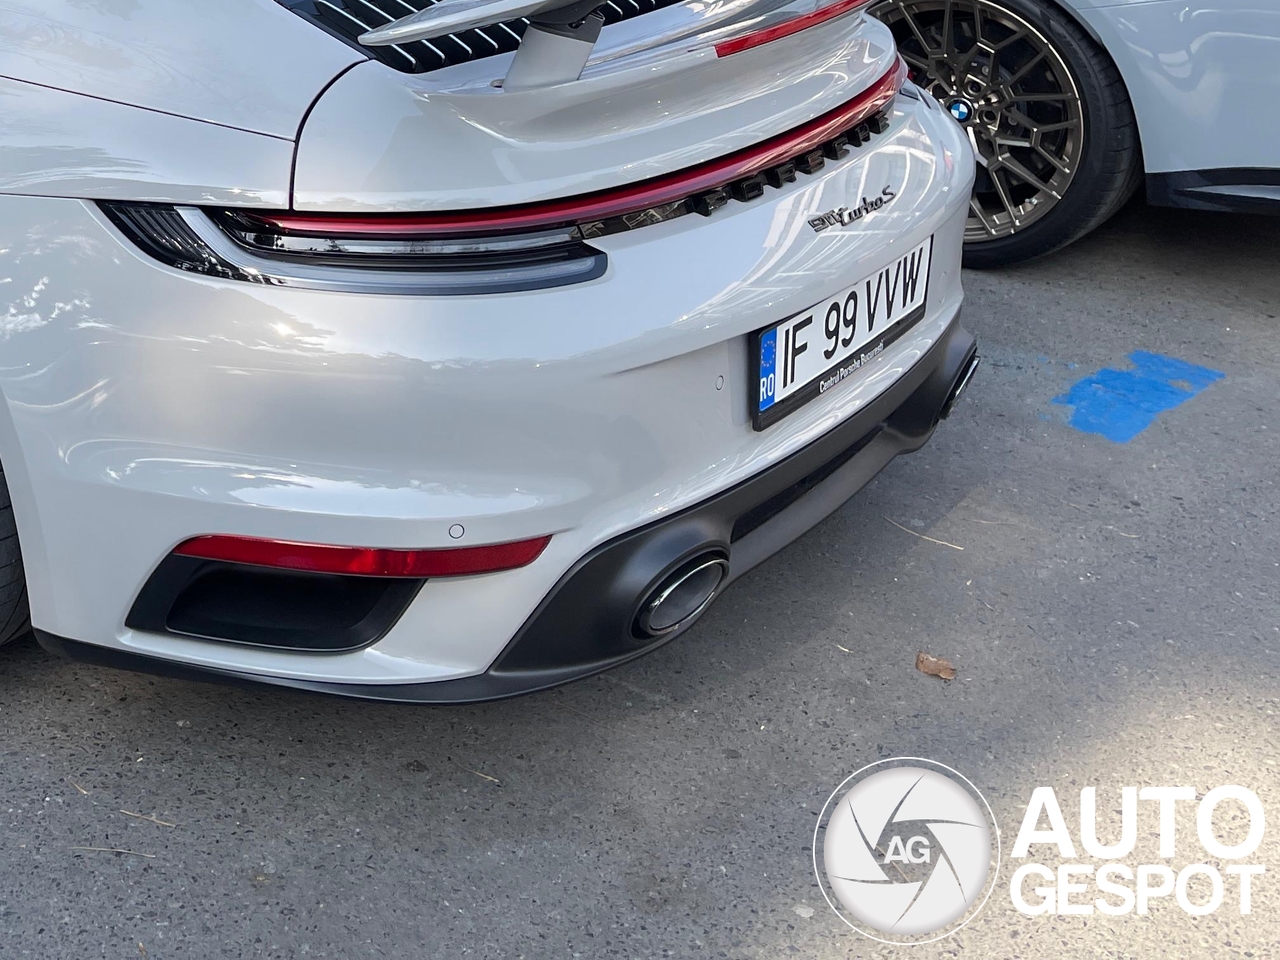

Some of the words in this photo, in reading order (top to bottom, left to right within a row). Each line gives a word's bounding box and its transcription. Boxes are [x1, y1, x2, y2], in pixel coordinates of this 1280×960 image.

[882, 184, 896, 204] S
[782, 314, 814, 389] IF
[823, 290, 858, 360] 99
[866, 246, 924, 333] VVW
[760, 374, 775, 402] RO
[820, 370, 840, 393] Centrul
[840, 359, 860, 380] Porsche
